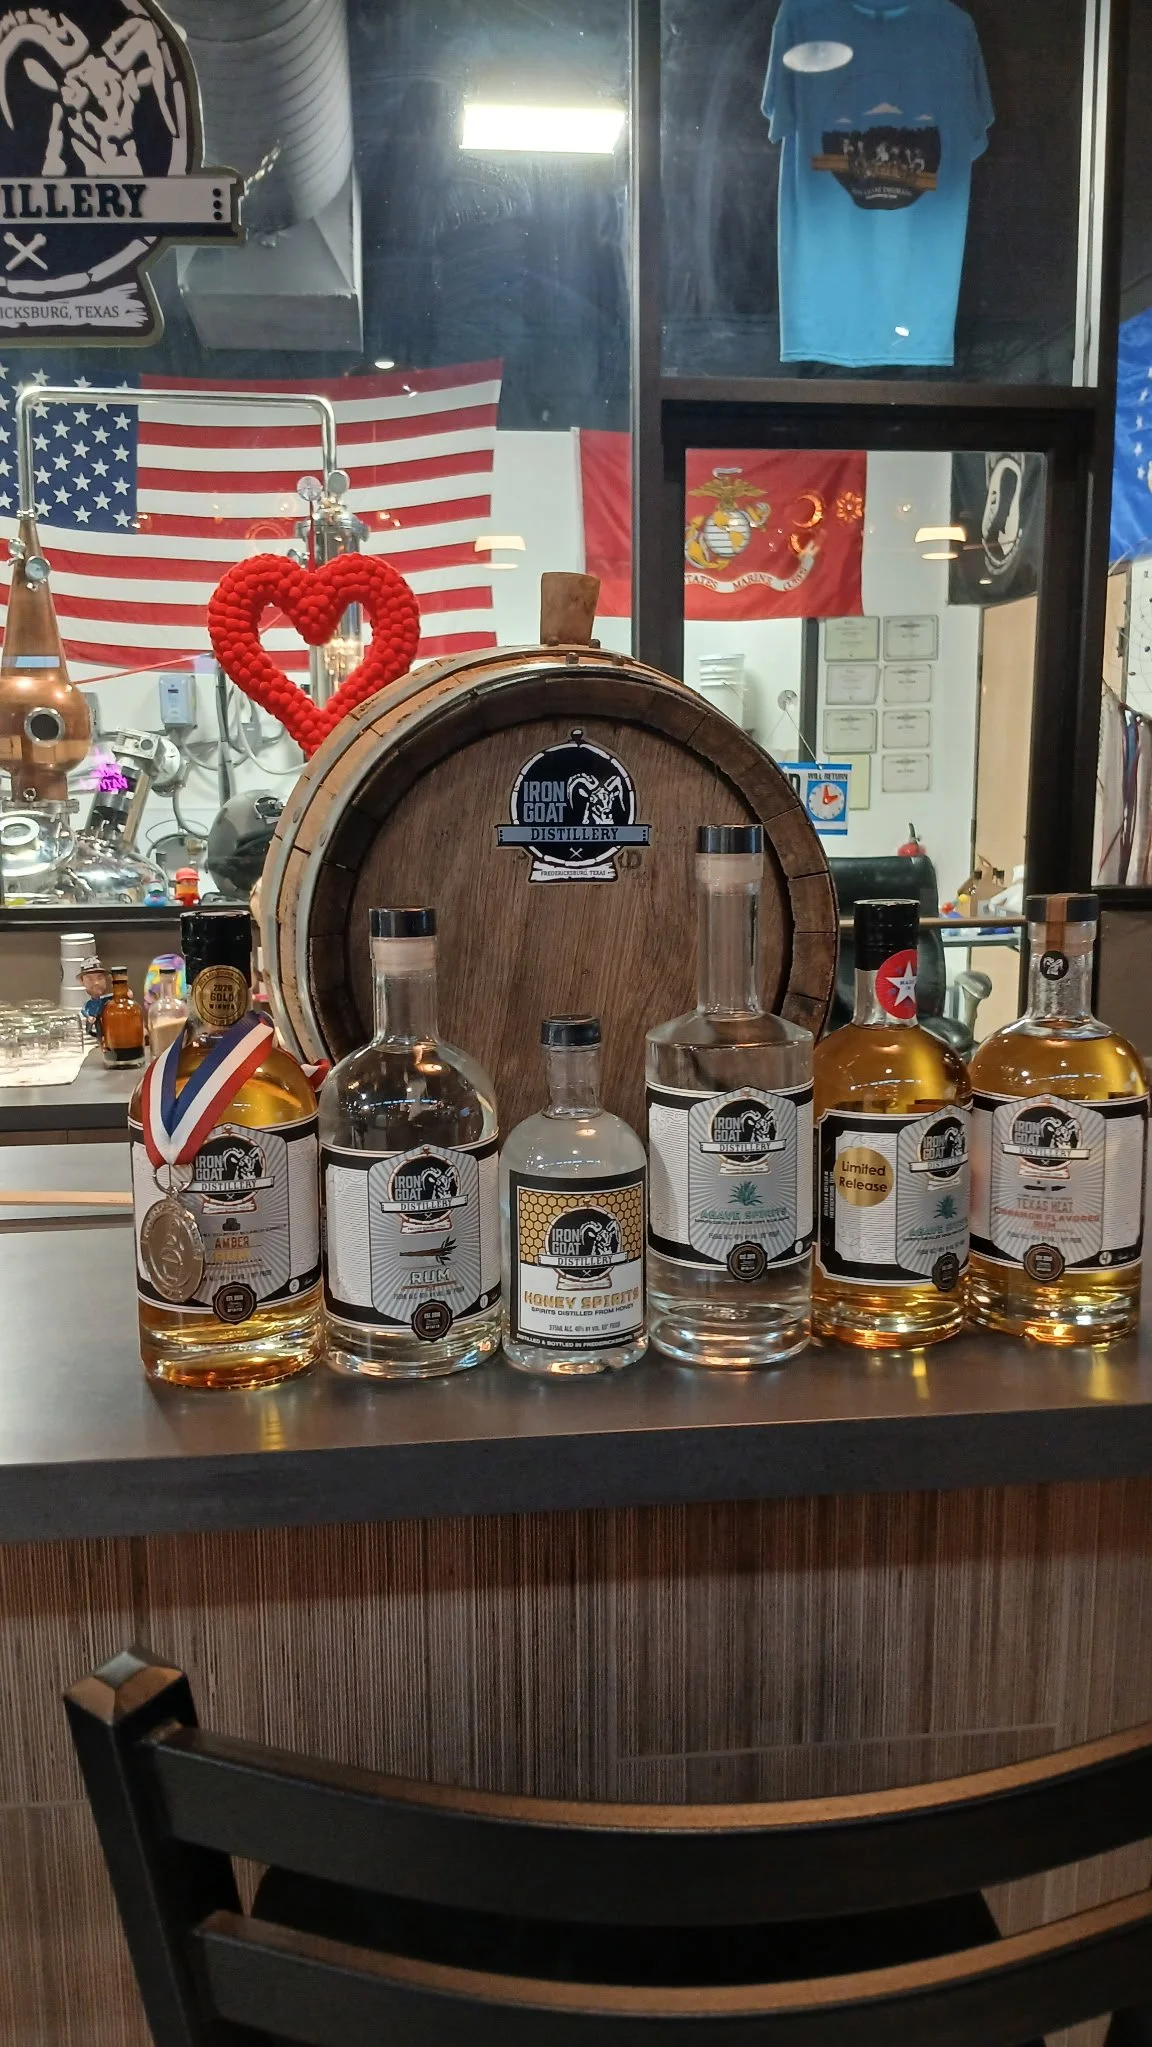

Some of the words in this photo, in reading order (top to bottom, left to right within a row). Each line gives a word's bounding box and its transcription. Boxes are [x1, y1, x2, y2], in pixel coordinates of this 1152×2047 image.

[75, 304, 119, 319] TEXAS
[732, 572, 774, 591] MARINE
[807, 772, 822, 780] WILL
[824, 772, 848, 780] RETURN
[523, 780, 565, 802] IRON
[523, 802, 567, 823] GOAT
[530, 827, 619, 841] DISTILLERY
[210, 991, 234, 1002] GOLD
[714, 1116, 742, 1130] IRON
[1014, 1121, 1041, 1135] IRON
[714, 1129, 742, 1142] GOAT
[922, 1134, 948, 1149] IRON
[1014, 1132, 1041, 1146] GOAT
[719, 1141, 771, 1154] DISTILLERY
[922, 1146, 947, 1160] GOAT
[195, 1154, 223, 1168] IRON
[195, 1167, 225, 1181] GOAT
[841, 1160, 887, 1177] Limited
[201, 1179, 257, 1192] DISTILLERY
[394, 1175, 422, 1188] IRON
[839, 1176, 888, 1193] Release
[394, 1187, 423, 1201] GOAT
[400, 1199, 451, 1211] DISTILLERY
[1016, 1198, 1049, 1212] TEXAS
[1051, 1200, 1074, 1213] HEAT
[1032, 1220, 1056, 1229] RUM
[1045, 1214, 1100, 1223] FLAVORED
[214, 1235, 250, 1249] AMBER
[551, 1228, 581, 1242] IRON
[551, 1241, 582, 1256] GOAT
[556, 1255, 613, 1267] DISTILLERY
[410, 1267, 450, 1285] RUM
[524, 1290, 577, 1310] HONEY
[581, 1286, 640, 1310] SPIRITS
[531, 1307, 556, 1316] SPIRITS
[557, 1309, 593, 1317] DISTILLED
[594, 1307, 615, 1316] FROM
[616, 1303, 634, 1313] HONEY
[516, 1332, 541, 1344] DISTILLED
[546, 1340, 575, 1349] BOTTLED
